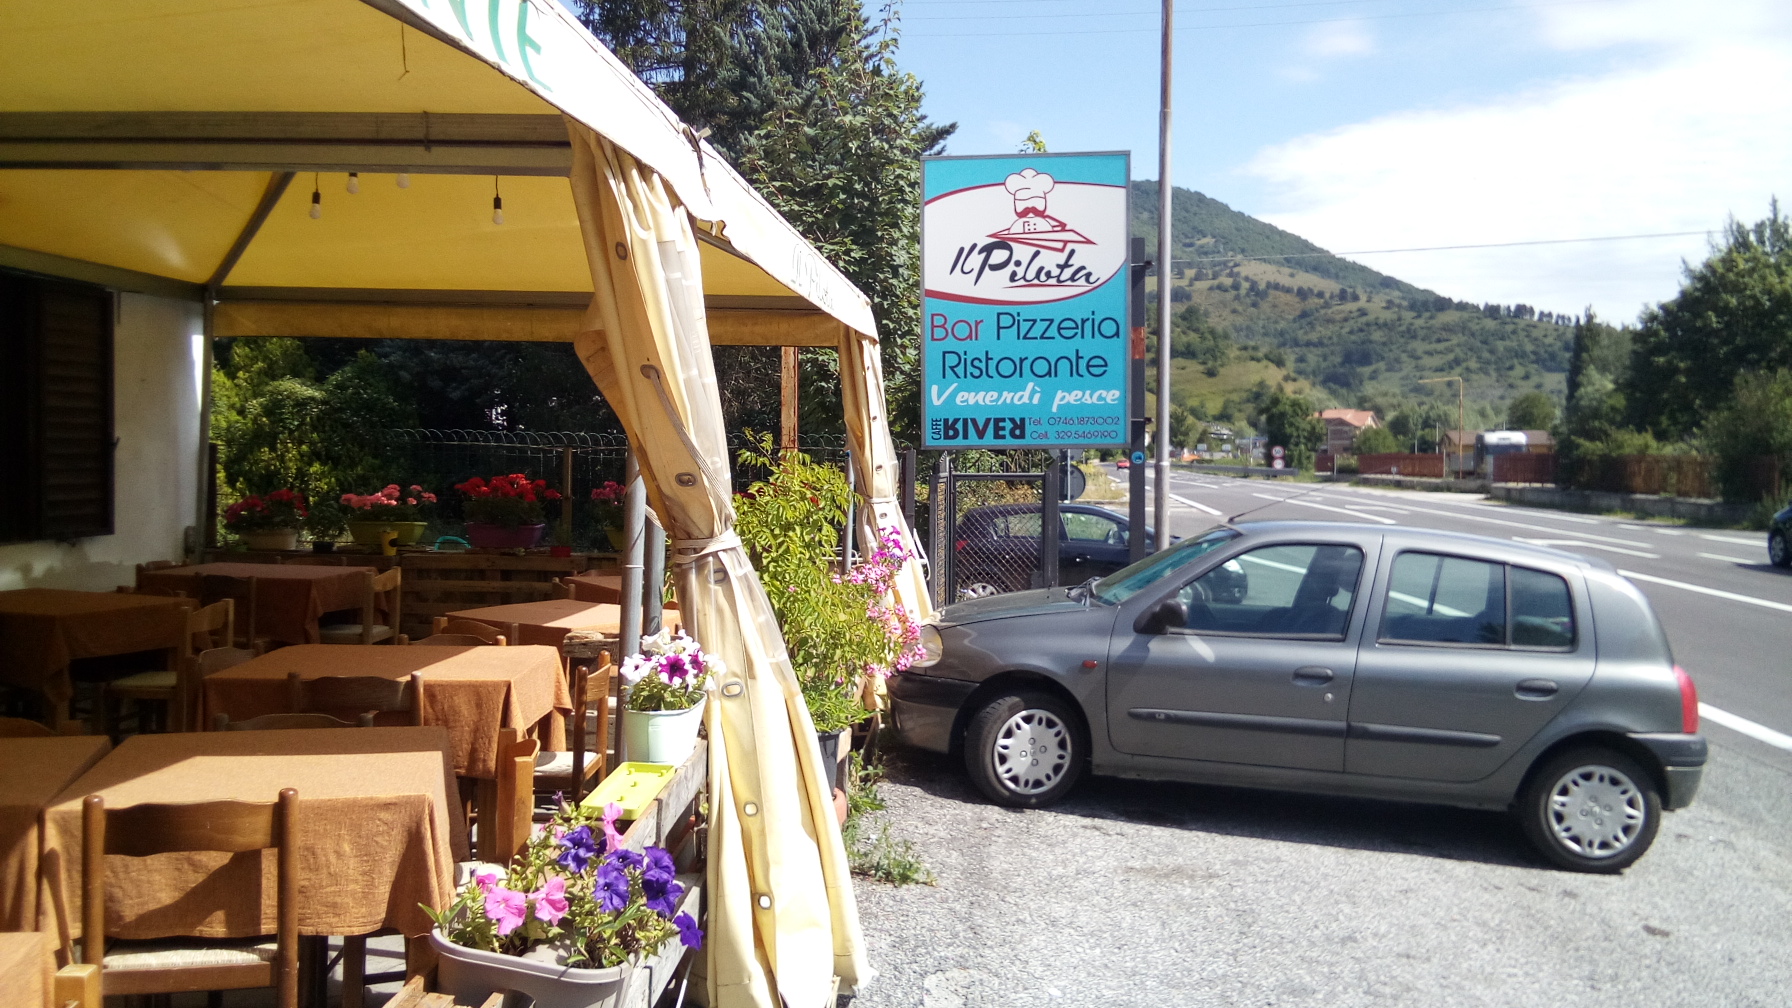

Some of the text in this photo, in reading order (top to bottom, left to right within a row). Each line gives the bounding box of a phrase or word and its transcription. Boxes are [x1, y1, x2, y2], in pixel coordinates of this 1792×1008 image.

[974, 240, 1102, 286] Pilota
[930, 311, 1120, 342] Bar Pizzeria
[942, 349, 1108, 379] Ristorante
[930, 382, 1120, 412] Venerdì pesce
[943, 417, 1026, 440] RIVER
[1047, 416, 1120, 426] 0746.1873002
[1054, 430, 1118, 439] 329.5469190
